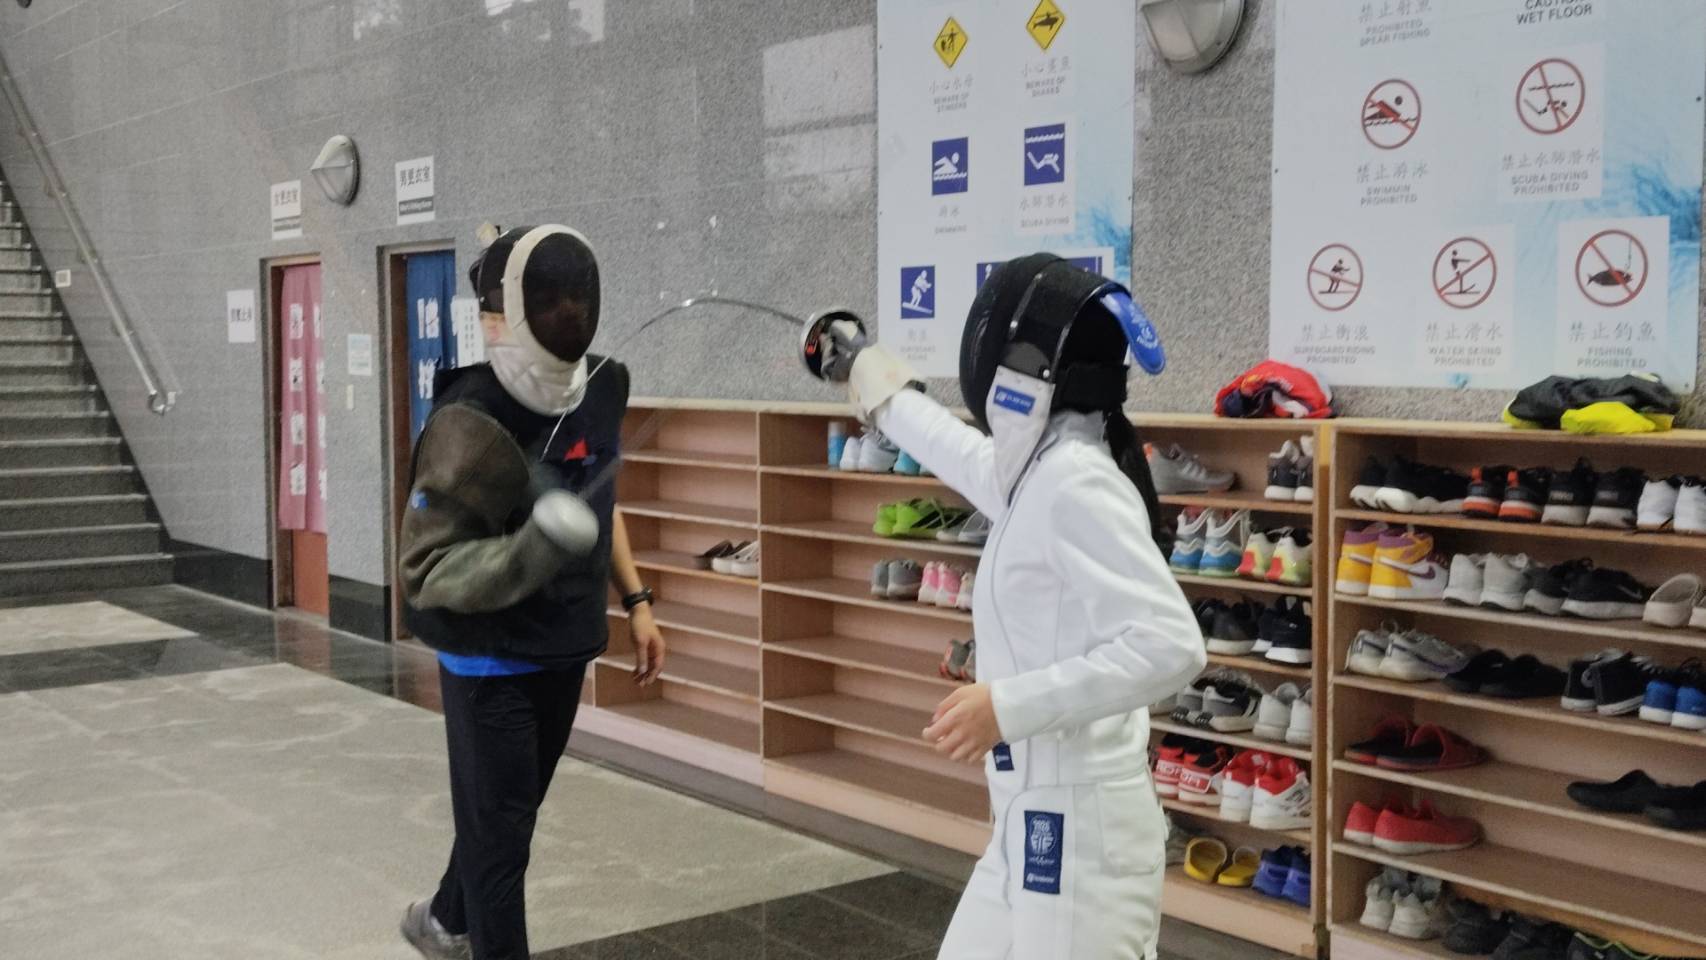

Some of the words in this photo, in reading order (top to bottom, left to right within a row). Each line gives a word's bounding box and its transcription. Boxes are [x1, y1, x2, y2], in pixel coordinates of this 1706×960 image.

[1516, 9, 1545, 25] WET
[1548, 3, 1593, 21] FLOOR
[1365, 18, 1423, 35] PROHIBITED
[1392, 27, 1431, 42] FISHING
[1511, 172, 1547, 185] SCUBA
[1550, 170, 1589, 182] DIVING
[1513, 182, 1581, 195] PROHIBITED
[1360, 193, 1418, 207] PROHIBITED
[1428, 346, 1465, 355] WATER
[1467, 346, 1502, 355] SKIING
[1587, 346, 1633, 357] FISHING
[1306, 355, 1357, 365] PROHIBITED
[1433, 357, 1496, 367] PROHIBITED
[1577, 357, 1648, 369] PROHIBITED
